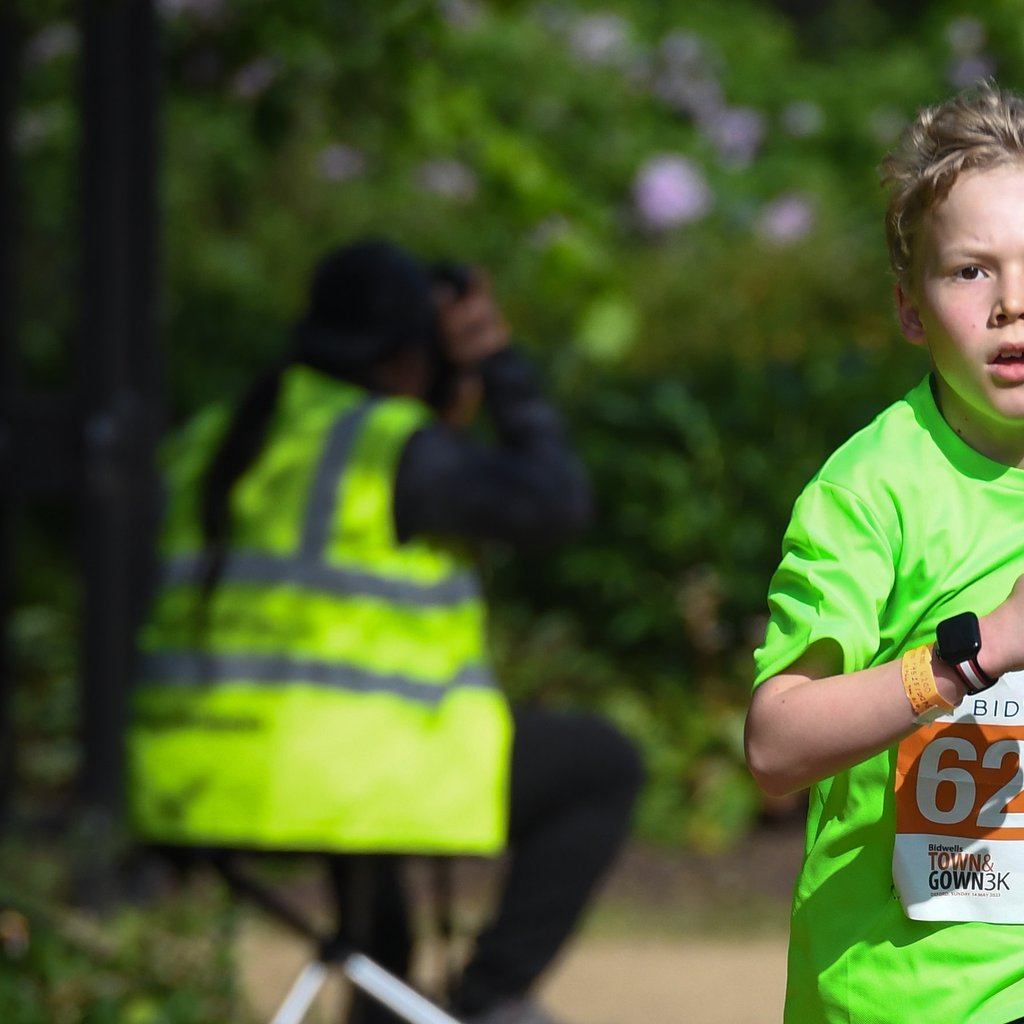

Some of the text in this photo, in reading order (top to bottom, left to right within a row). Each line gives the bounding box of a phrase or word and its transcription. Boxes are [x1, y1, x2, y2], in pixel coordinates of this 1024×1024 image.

[928, 843, 963, 853] Bidwells
[928, 851, 994, 872] TOWN&
[928, 870, 1011, 891] GOWN3K
